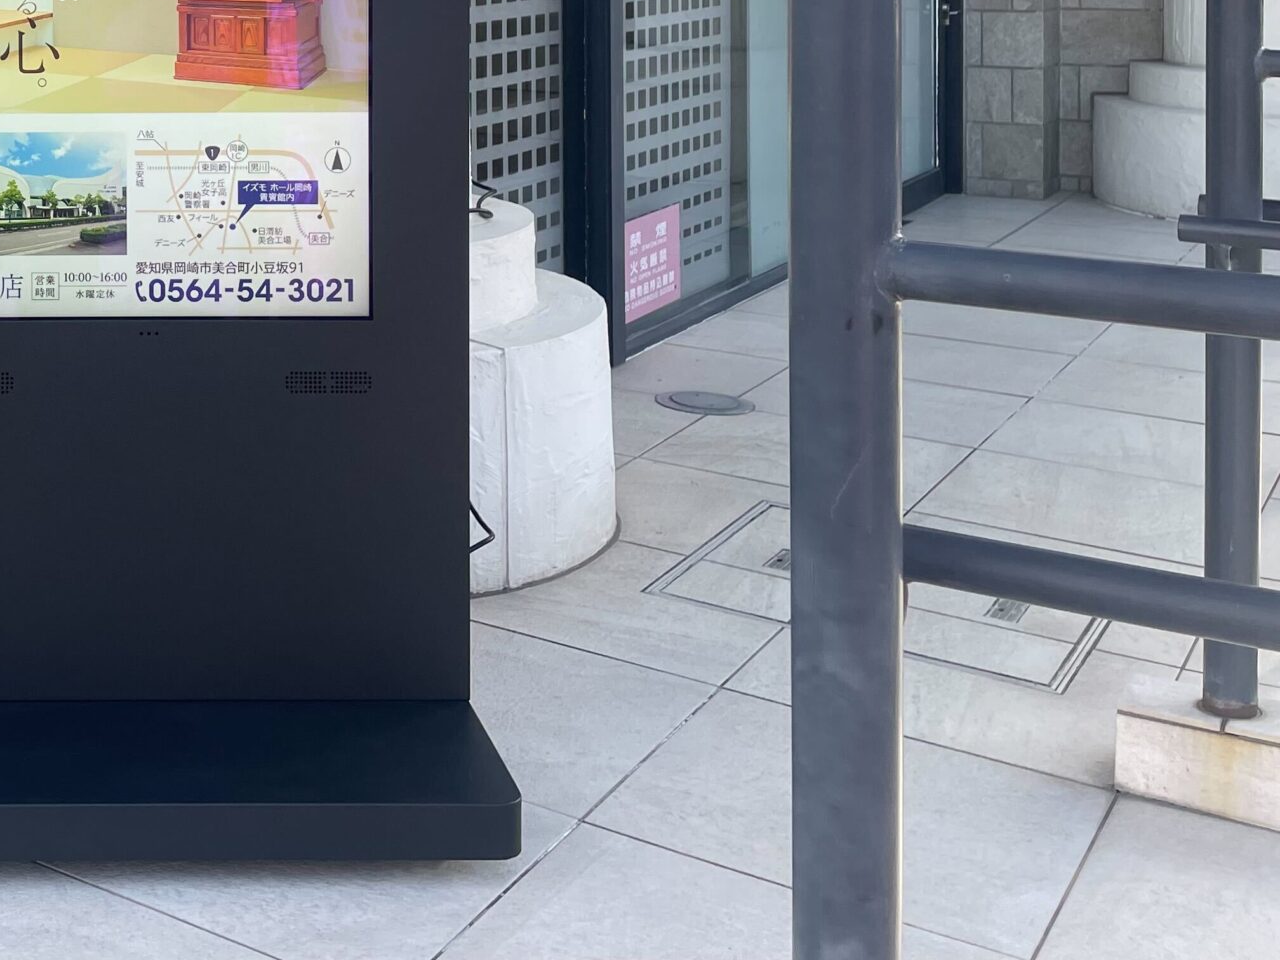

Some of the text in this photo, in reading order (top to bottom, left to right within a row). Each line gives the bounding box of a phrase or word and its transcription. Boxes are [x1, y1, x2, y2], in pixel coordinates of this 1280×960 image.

[201, 163, 228, 172] 東岡崎
[250, 163, 268, 172] 男川
[242, 183, 267, 192] イズモ
[184, 191, 201, 200] 岡崎
[201, 188, 227, 197] 女子高
[323, 189, 355, 198] デニーズ
[184, 200, 210, 209] 警察署
[158, 215, 175, 223] 西友
[188, 214, 218, 222] フィール
[154, 239, 185, 247] デニーズ
[258, 236, 292, 245] 美合工場
[311, 234, 328, 243] 美合
[136, 261, 304, 275] 愛知県岡崎市美合町小豆坂91
[34, 274, 56, 286] 営業
[34, 286, 56, 299] 時間
[75, 289, 115, 300] 水曜定休
[149, 278, 355, 303] 0564-54-3021
